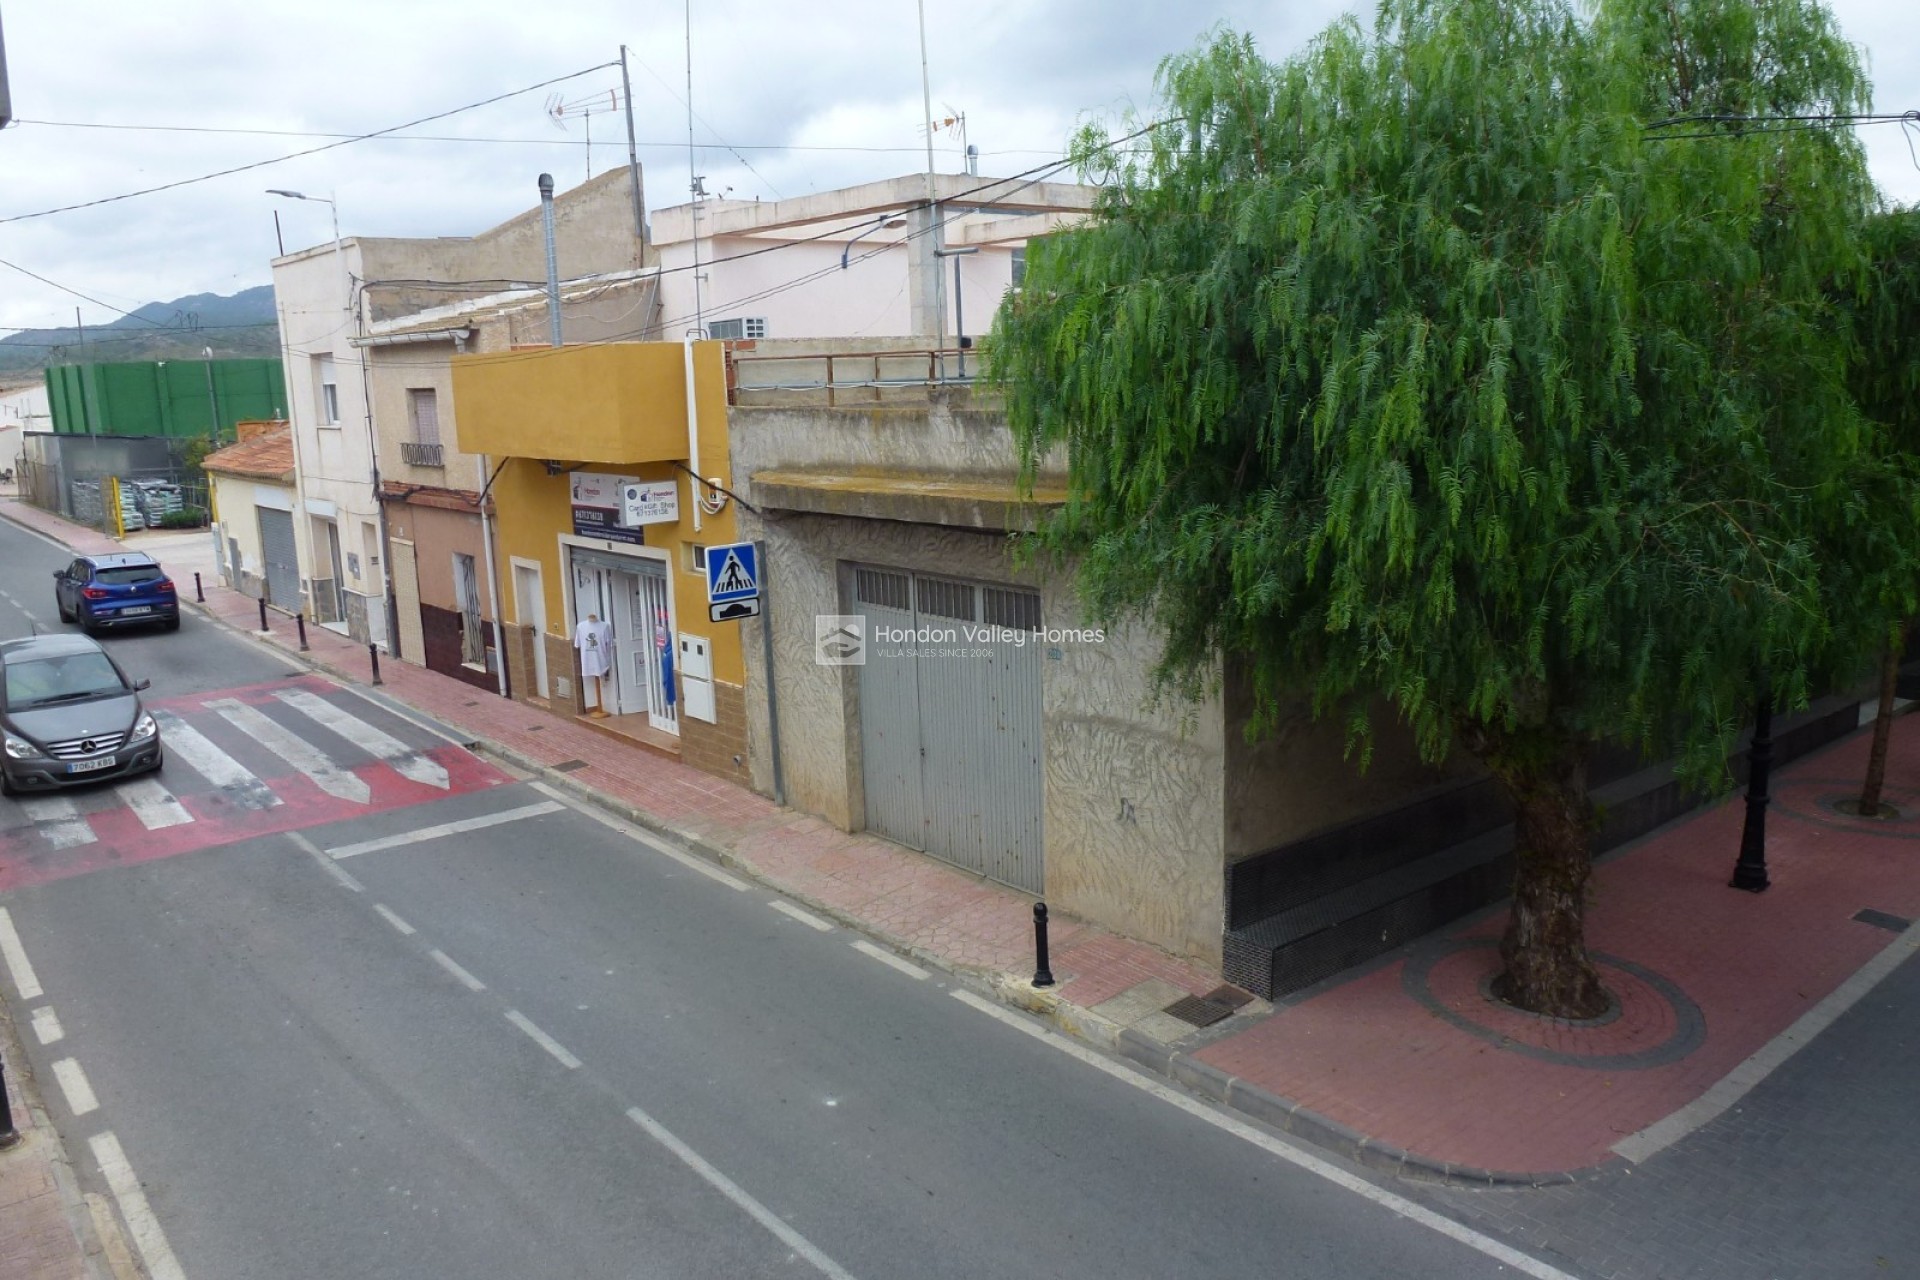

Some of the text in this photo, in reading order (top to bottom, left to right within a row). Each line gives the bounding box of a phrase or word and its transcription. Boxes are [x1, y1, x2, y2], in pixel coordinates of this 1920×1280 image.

[629, 504, 643, 513] Card
[660, 501, 675, 510] Shop
[73, 761, 95, 770] 7062
